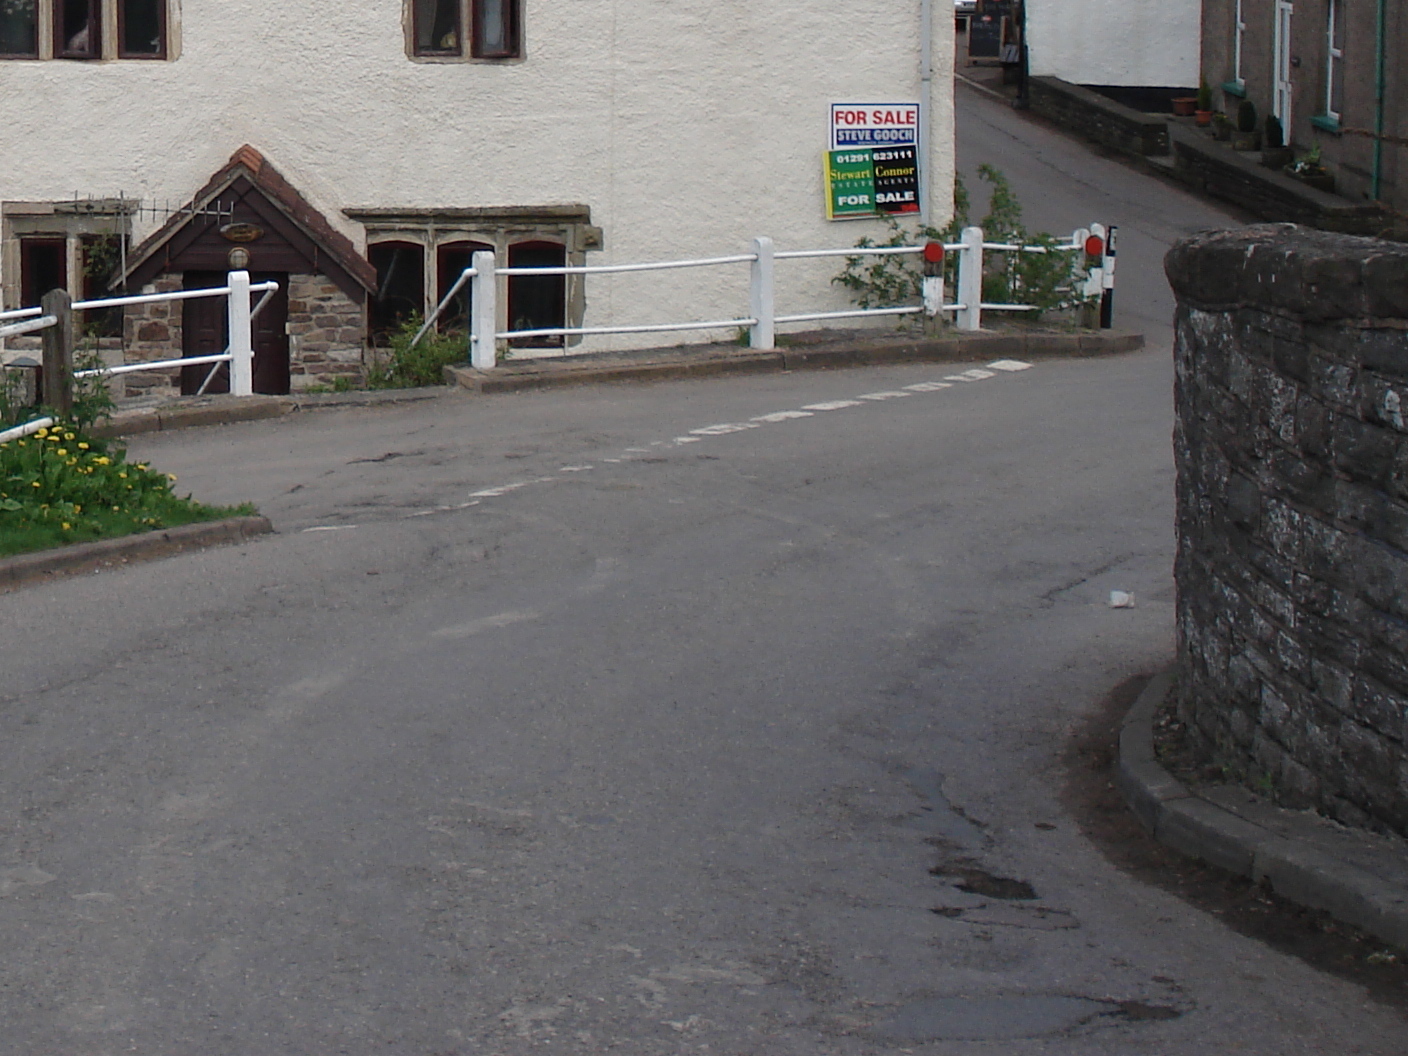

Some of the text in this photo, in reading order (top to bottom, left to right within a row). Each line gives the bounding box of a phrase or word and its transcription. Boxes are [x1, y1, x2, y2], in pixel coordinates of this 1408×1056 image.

[835, 110, 915, 125] FOR SALE
[838, 129, 912, 141] STEVE GOOCH
[837, 150, 912, 163] 01291 623111
[830, 166, 914, 181] Stewart Connor
[838, 191, 915, 206] FOR SALE
